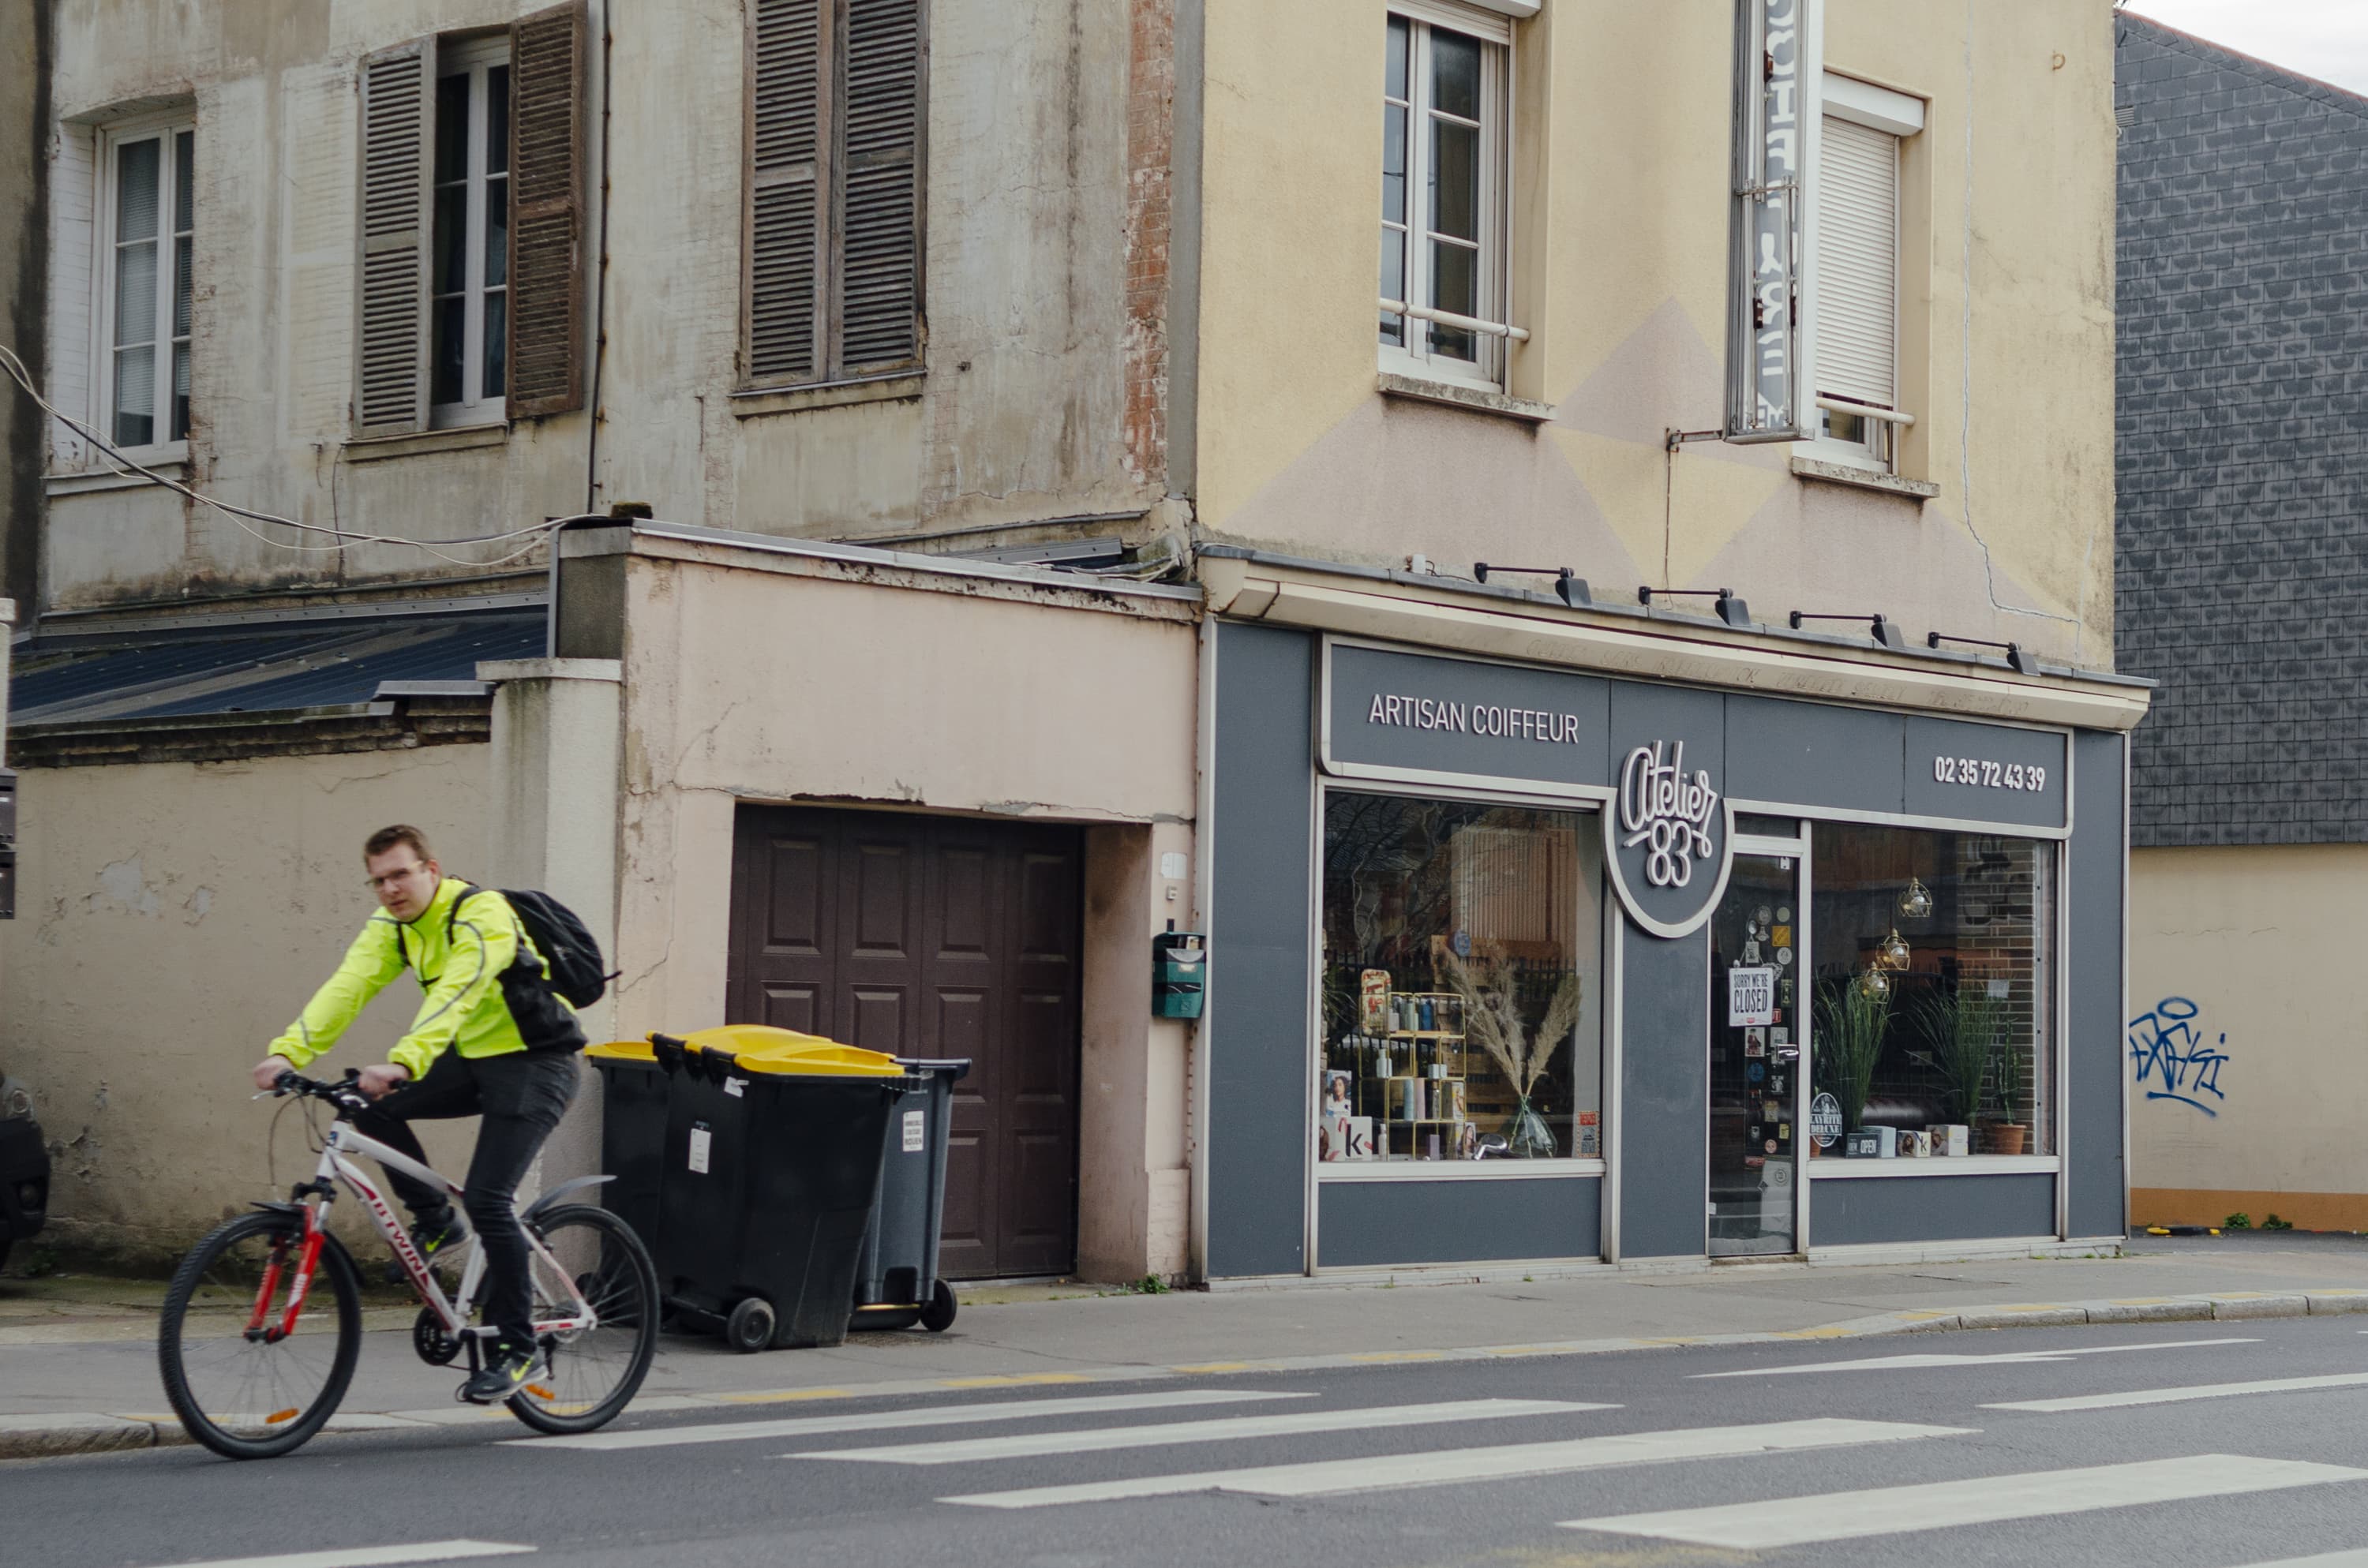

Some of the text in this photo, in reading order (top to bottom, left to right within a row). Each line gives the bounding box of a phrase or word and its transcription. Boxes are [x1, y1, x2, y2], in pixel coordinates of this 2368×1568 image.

[1369, 694, 1579, 744] ARTISAN COIFFEUR
[1935, 756, 2045, 791] 02 35 72 43 39
[1621, 739, 1718, 858] Atelier
[1647, 819, 1692, 887] 83
[1734, 973, 1768, 988] SORRY WE'RE
[1734, 989, 1767, 1013] CLOSED
[1811, 1125, 1840, 1133] DELUXE
[1860, 1140, 1877, 1154] OPEN
